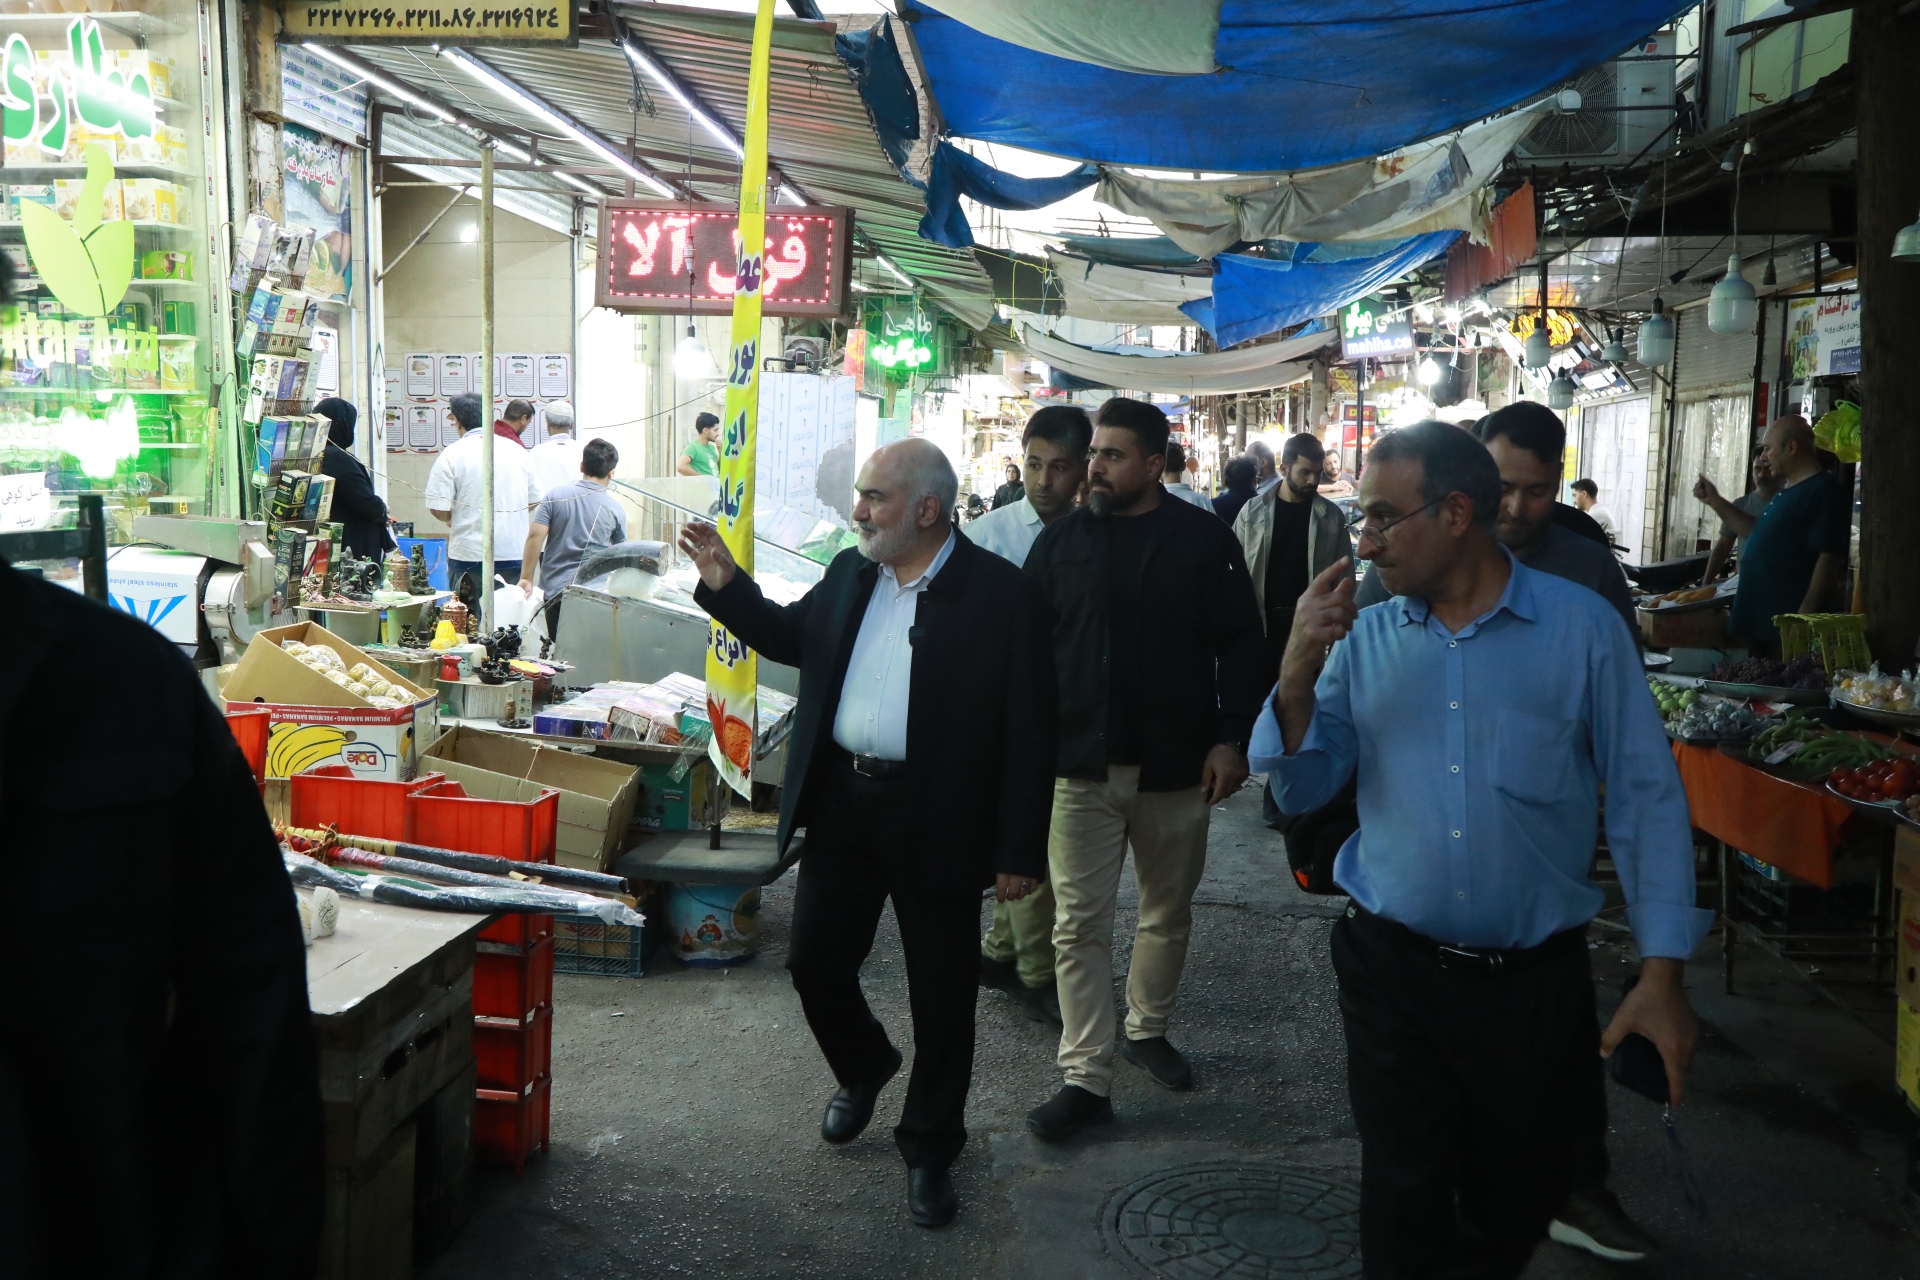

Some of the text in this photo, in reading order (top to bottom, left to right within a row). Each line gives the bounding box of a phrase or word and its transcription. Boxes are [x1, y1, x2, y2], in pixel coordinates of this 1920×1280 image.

[623, 216, 697, 276] آلا
[886, 313, 932, 337] ماهی
[1345, 301, 1373, 338] میگو
[93, 317, 158, 371] Azizi
[16, 515, 36, 527] رسید
[108, 577, 126, 585] shee
[127, 578, 145, 586] steel
[364, 715, 391, 723] PREMIUM
[347, 752, 377, 766] Dole
